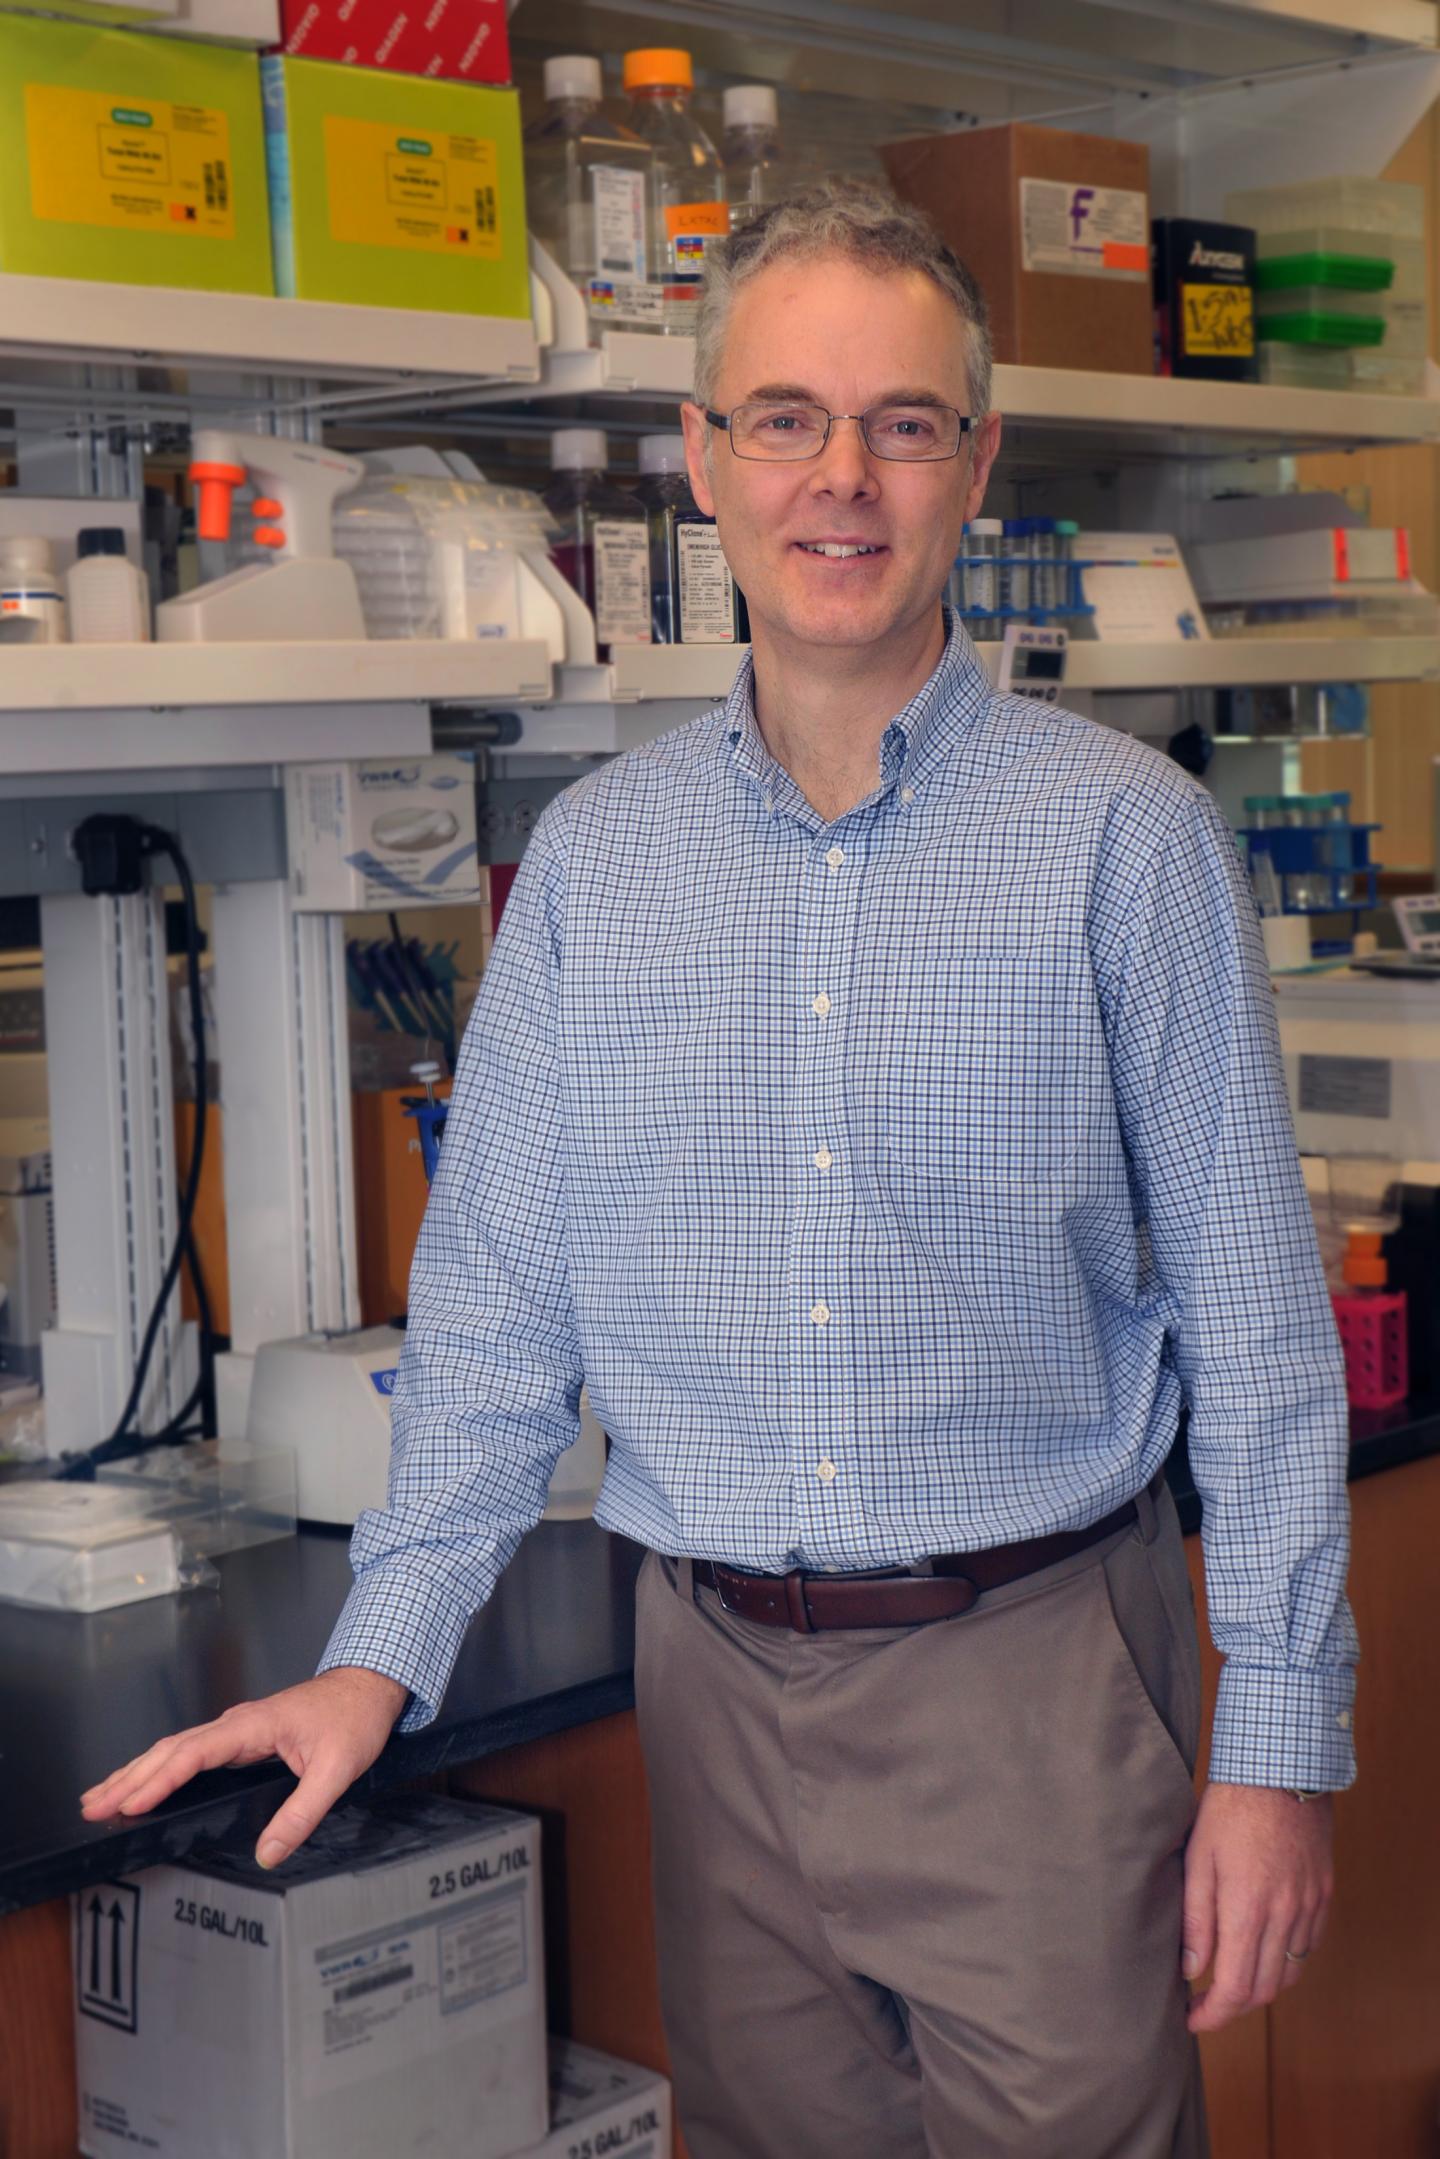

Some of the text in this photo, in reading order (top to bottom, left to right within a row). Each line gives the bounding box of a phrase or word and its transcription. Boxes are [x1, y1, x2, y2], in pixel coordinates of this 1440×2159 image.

[374, 12, 408, 64] QIAGEN
[429, 1875, 456, 1898] 2.5
[174, 1898, 196, 1925] 2.5
